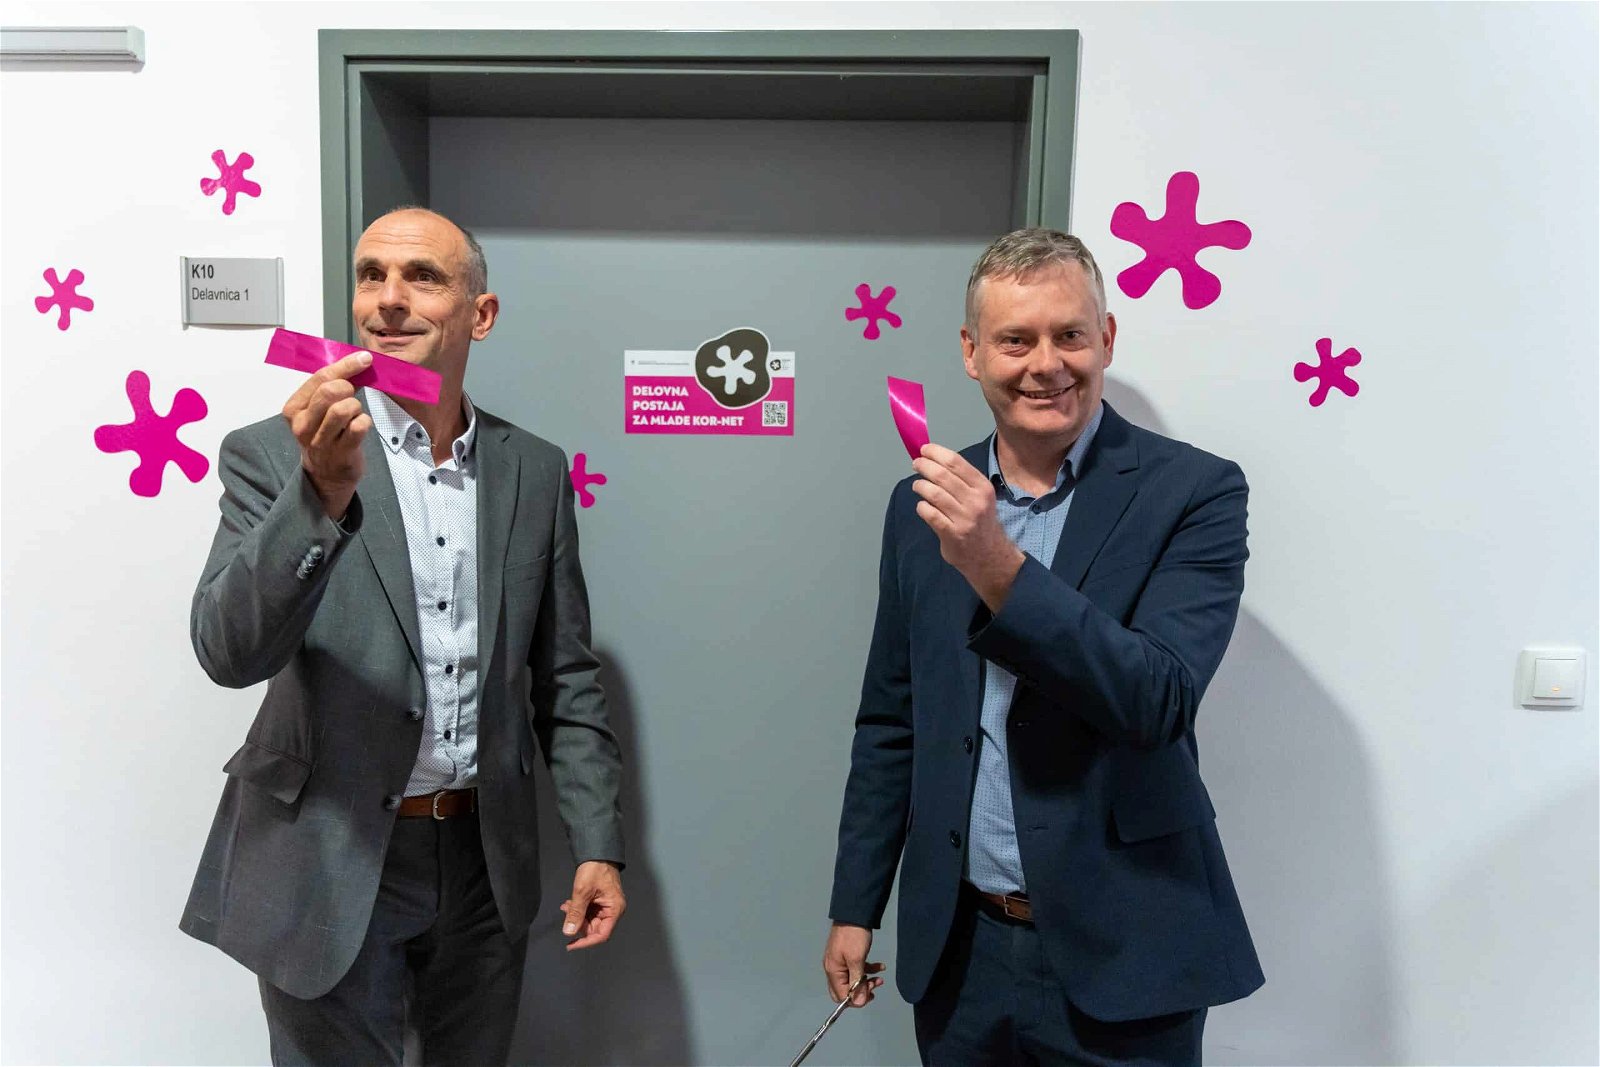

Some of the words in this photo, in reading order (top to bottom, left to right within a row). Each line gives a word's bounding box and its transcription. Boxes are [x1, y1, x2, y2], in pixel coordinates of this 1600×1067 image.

[192, 264, 215, 279] K10
[192, 287, 240, 301] Delavnica
[244, 288, 249, 301] 1
[632, 386, 689, 397] DELOVNA
[632, 400, 685, 411] POSTAJA
[632, 415, 648, 426] ZA
[650, 415, 691, 426] MLADE
[692, 415, 745, 427] KOR-NET
